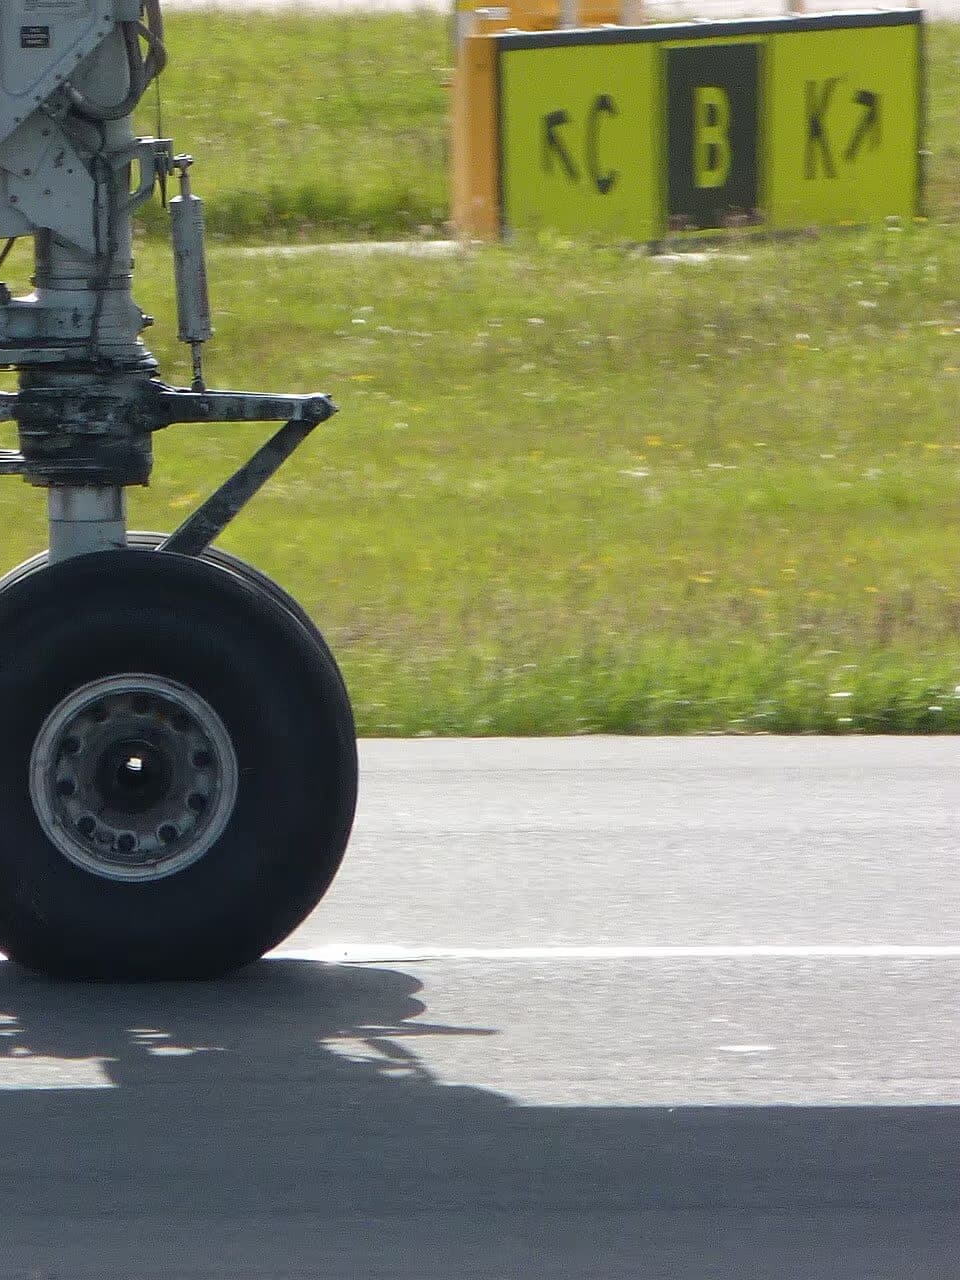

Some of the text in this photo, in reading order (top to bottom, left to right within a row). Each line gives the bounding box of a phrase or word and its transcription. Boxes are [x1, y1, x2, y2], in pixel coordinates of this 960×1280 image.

[586, 76, 843, 194] C B K
